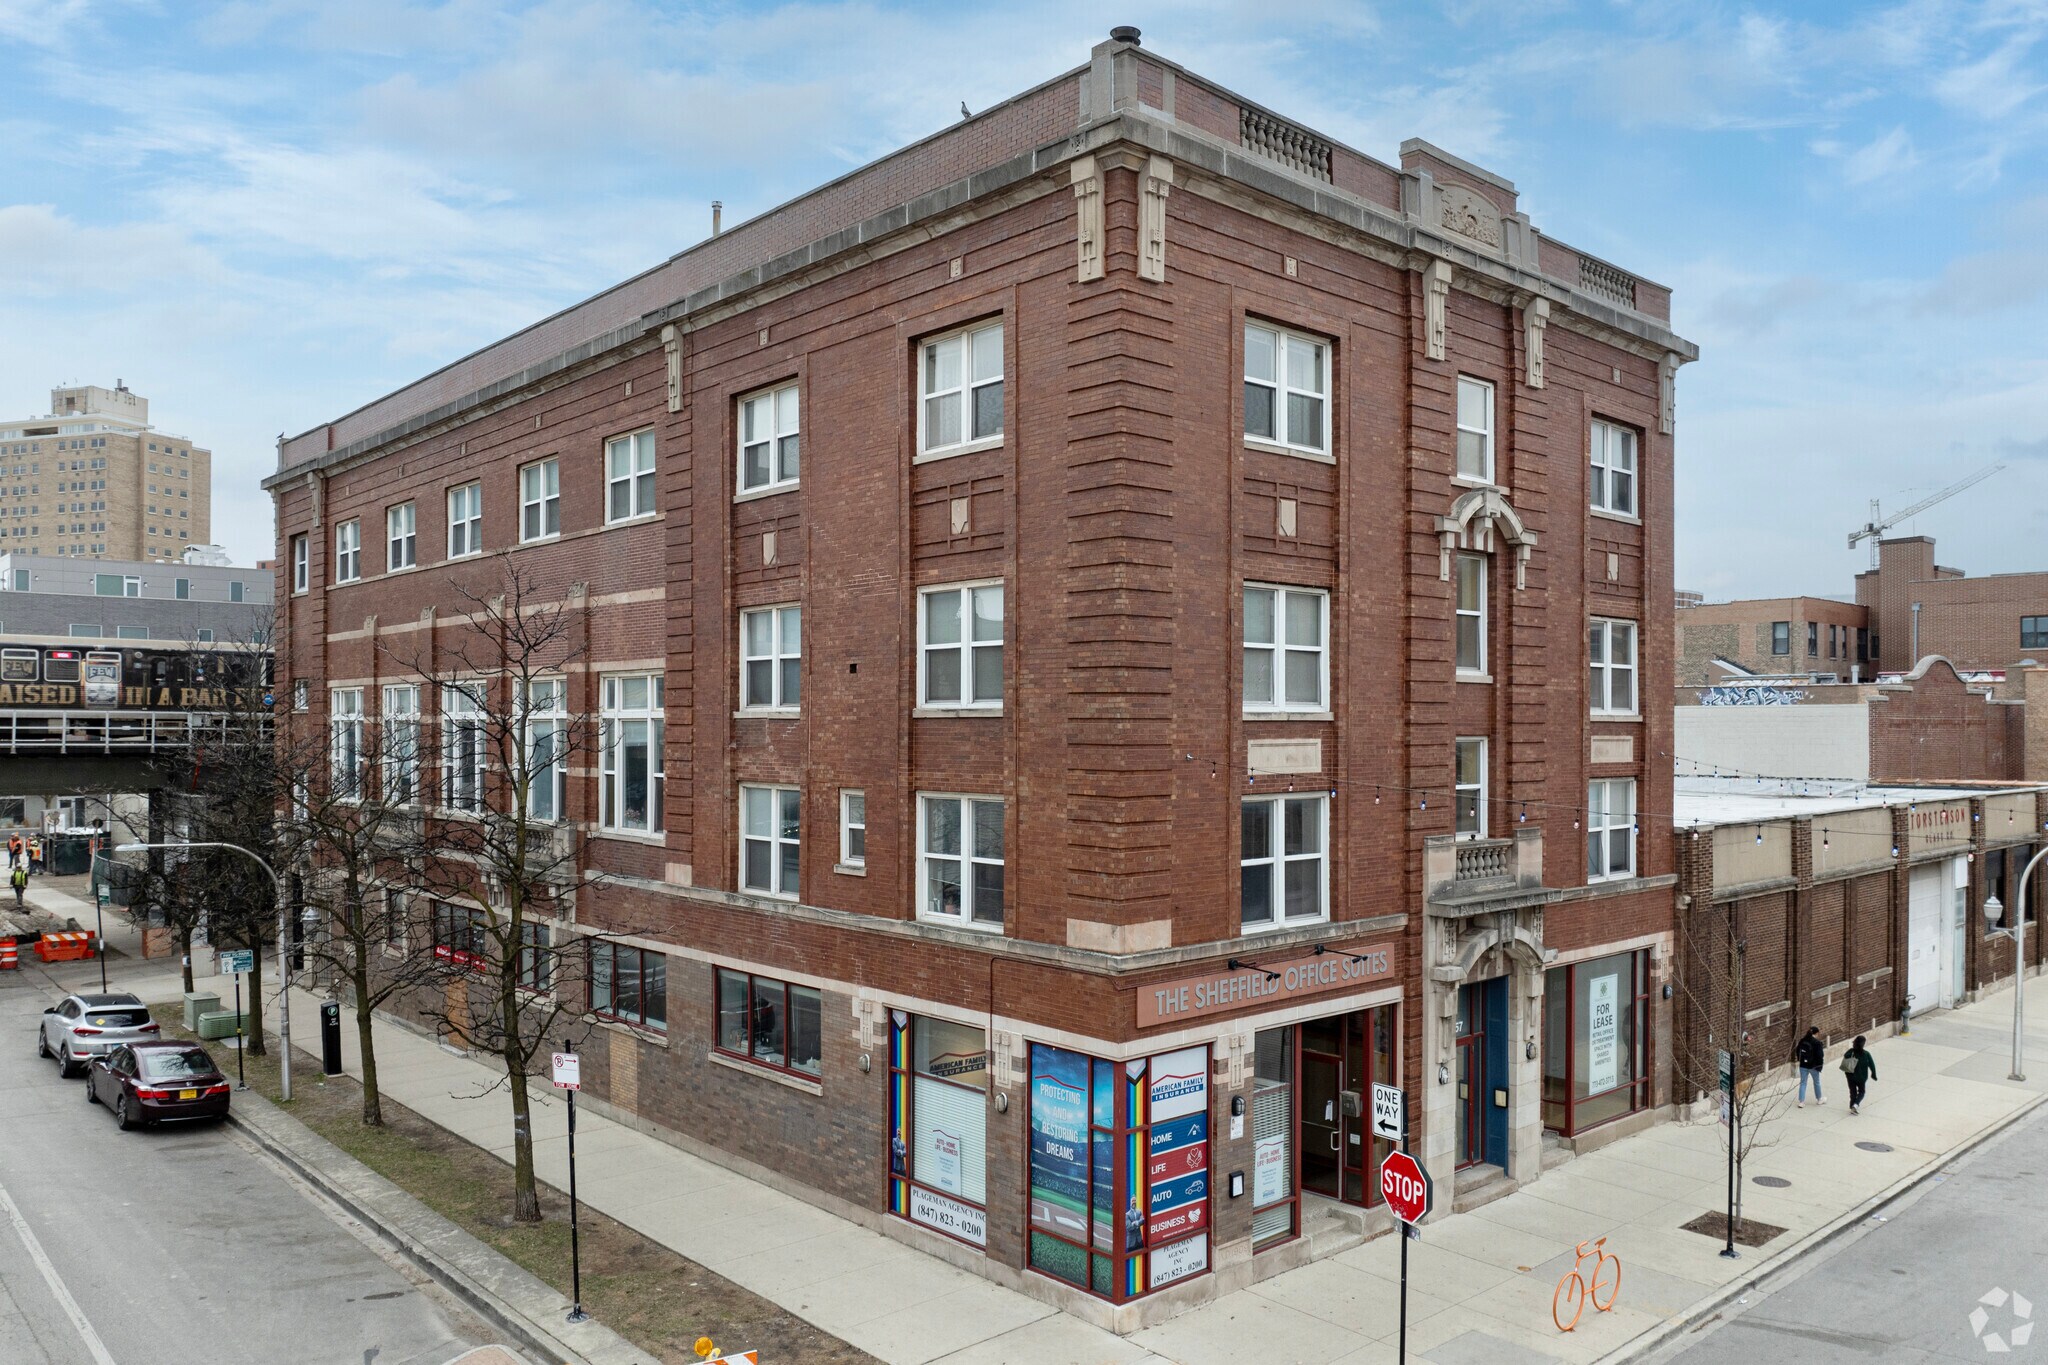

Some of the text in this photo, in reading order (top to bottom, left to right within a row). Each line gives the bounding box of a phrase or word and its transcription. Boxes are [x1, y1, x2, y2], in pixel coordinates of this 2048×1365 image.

[3, 660, 34, 673] FEW
[89, 666, 115, 678] FEW
[157, 687, 174, 706] A
[1155, 950, 1388, 1016] THE SHEFFIELD OFFICE SUITES
[1596, 1003, 1610, 1016] FOR
[1593, 1014, 1613, 1030] LEASE
[930, 1055, 986, 1071] AMERICAN FAMILY
[1040, 1083, 1080, 1105] PROTECTING
[1152, 1076, 1204, 1095] AMERICAN FAMILY
[1155, 1085, 1200, 1101] INSURANCE
[1376, 1088, 1398, 1105] ONE
[1053, 1106, 1067, 1121] AND
[1376, 1102, 1399, 1119] WAY
[1041, 1121, 1079, 1144] RESTORING
[1151, 1132, 1173, 1146] HOME
[1046, 1141, 1074, 1161] DREAMS
[1151, 1163, 1166, 1175] LIFE
[1384, 1169, 1423, 1205] STOP
[1152, 1189, 1172, 1203] AUTO
[912, 1189, 986, 1223] PLAGEMAN AGENCY INC
[917, 1203, 938, 1222] (847)
[939, 1211, 954, 1227] 823
[961, 1220, 982, 1237] 0200
[1150, 1215, 1186, 1234] BUSINESS
[1168, 1247, 1189, 1259] AGENCY
[1173, 1257, 1183, 1265] INC
[1153, 1271, 1170, 1286] (847)
[1171, 1266, 1183, 1278] 823
[1188, 1259, 1203, 1271] 0200
